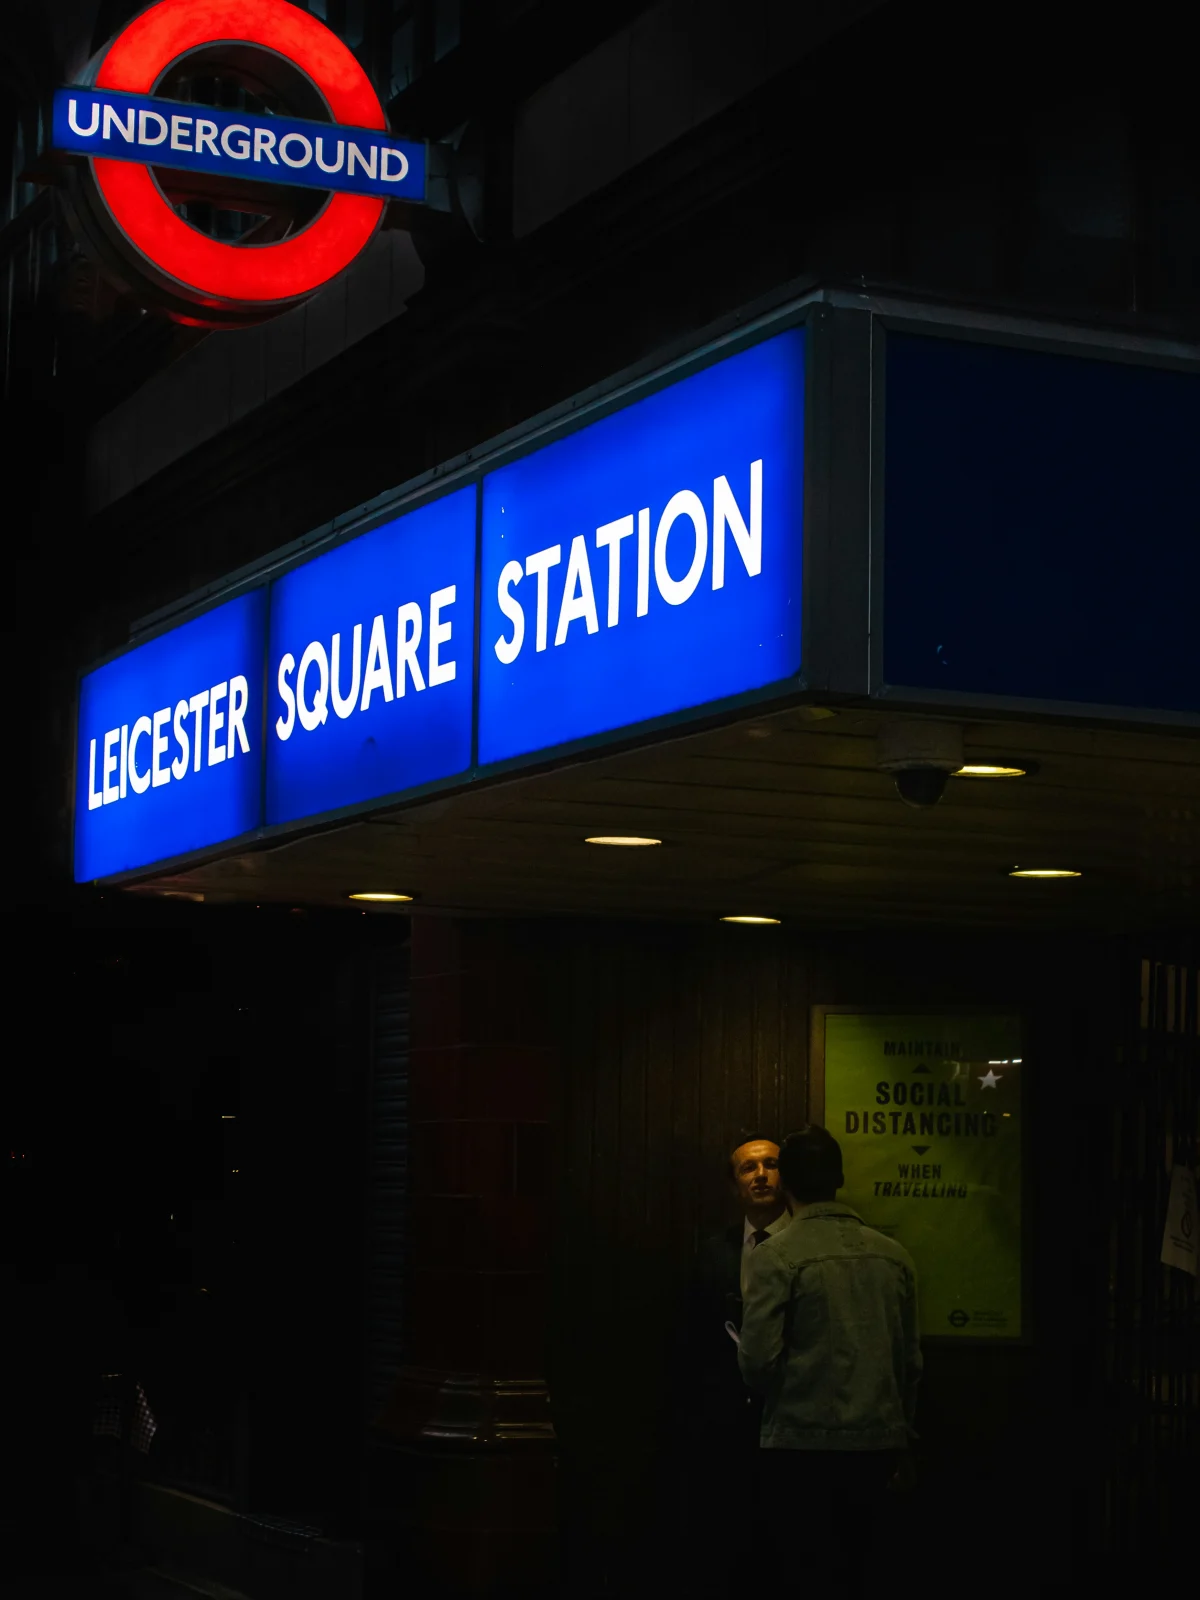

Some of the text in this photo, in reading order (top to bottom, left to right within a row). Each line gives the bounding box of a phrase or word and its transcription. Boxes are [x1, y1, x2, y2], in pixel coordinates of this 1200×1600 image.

[68, 99, 409, 182] UNDERGROUND
[88, 458, 763, 811] LEICESTER SQUARE STATION
[884, 1041, 962, 1057] MAINTAIN
[876, 1081, 966, 1106] SOCIAL
[845, 1111, 997, 1137] DISTANCING
[898, 1164, 942, 1179] WHEN
[873, 1182, 968, 1198] TRAVELLING
